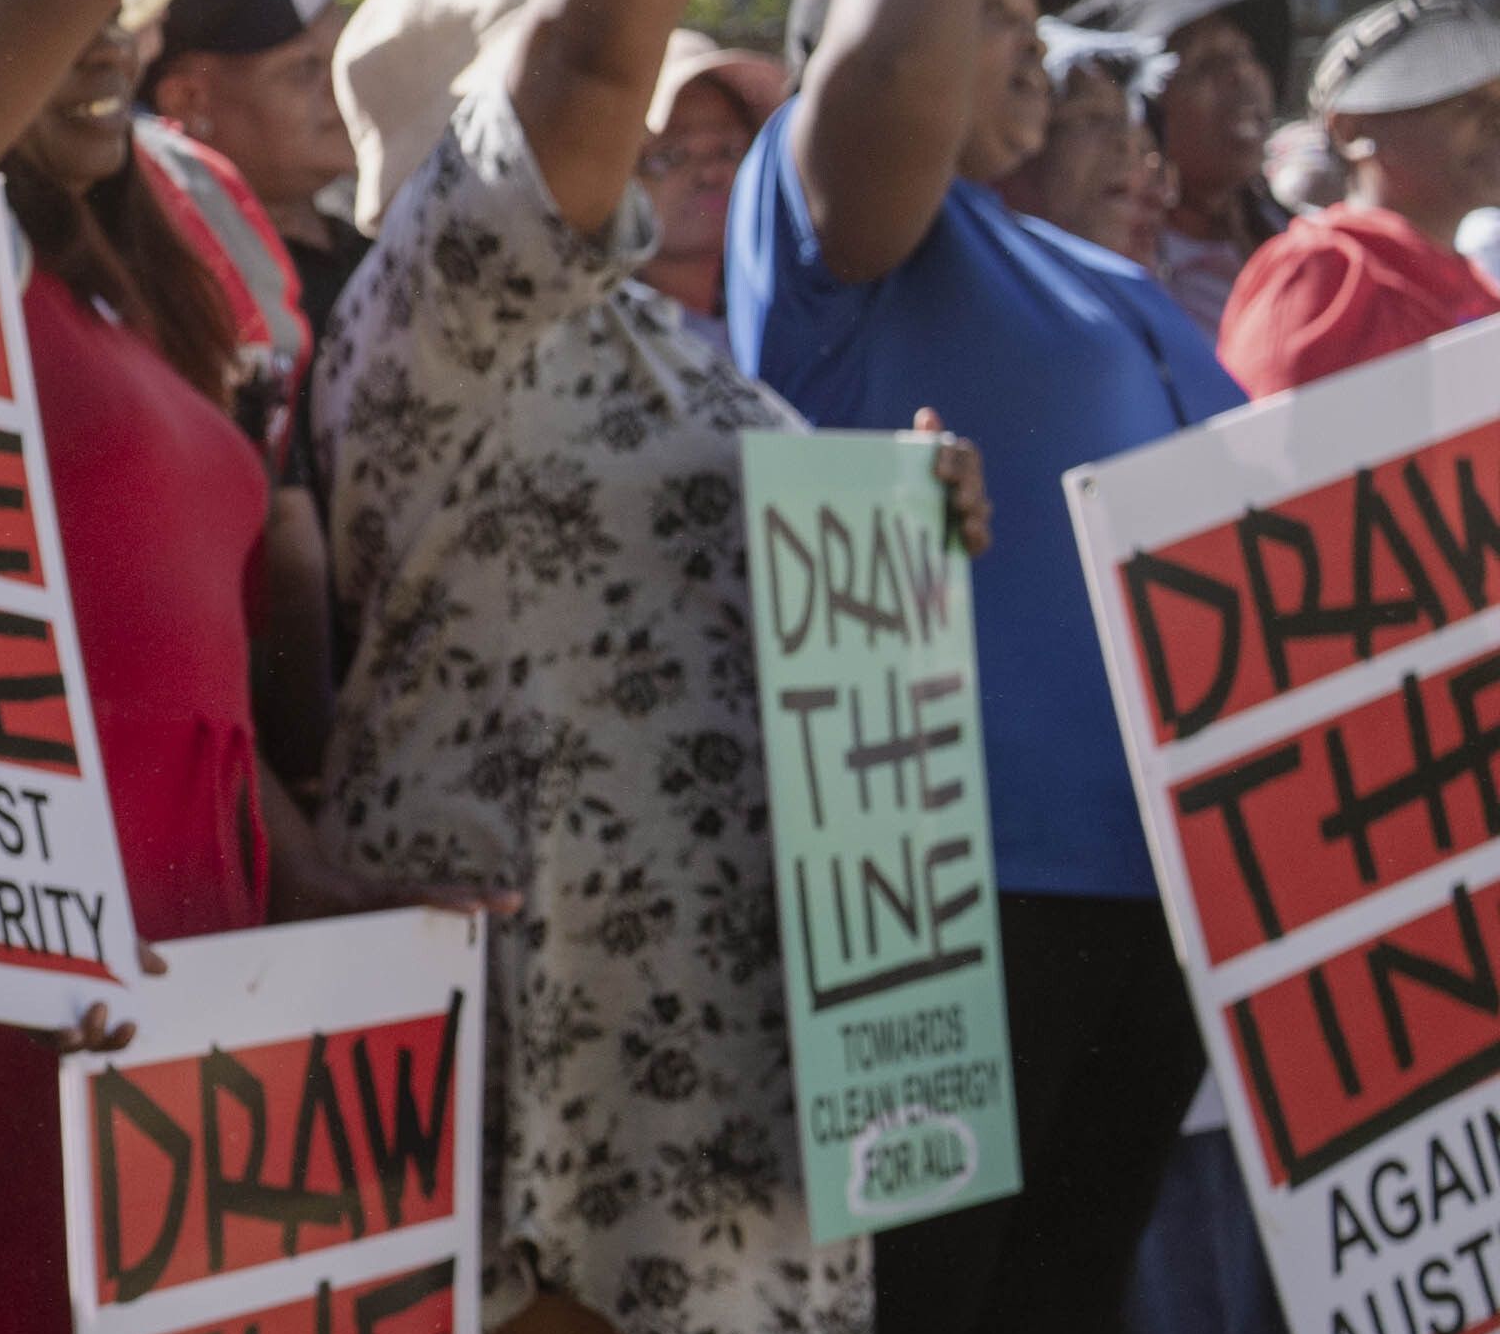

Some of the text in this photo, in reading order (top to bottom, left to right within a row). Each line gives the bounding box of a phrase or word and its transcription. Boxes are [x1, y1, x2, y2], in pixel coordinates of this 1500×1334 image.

[766, 504, 950, 657] DRAW
[781, 668, 964, 829] THE
[797, 835, 985, 1013] LINE
[1234, 882, 1500, 1188] LIN
[100, 987, 465, 1304] DRAW
[1330, 1106, 1500, 1275] AGAI
